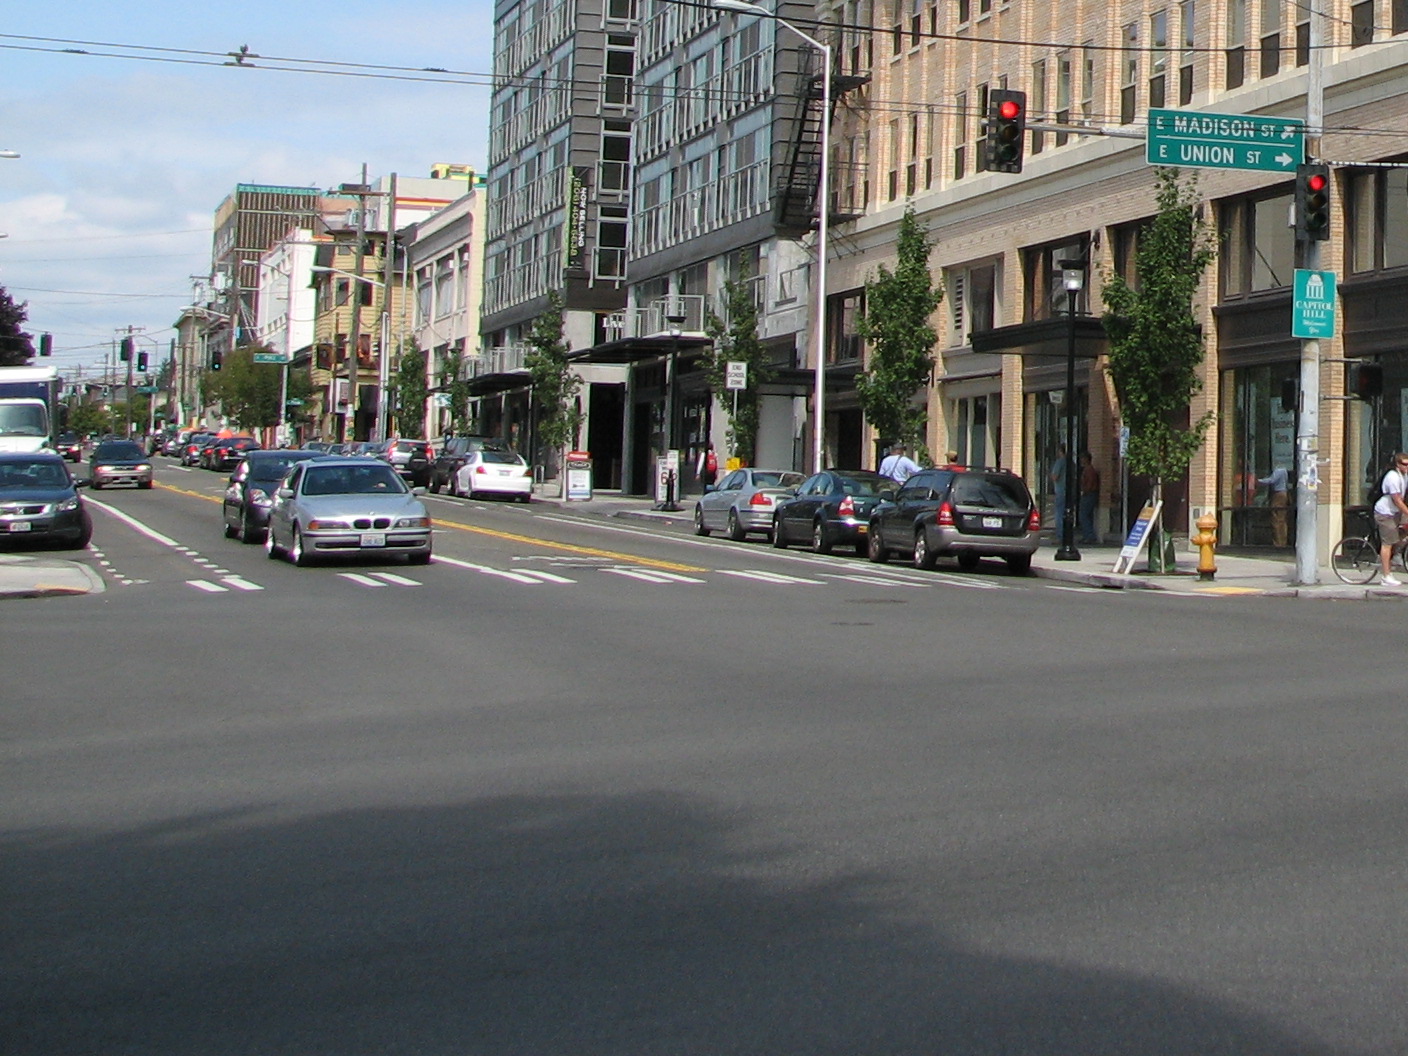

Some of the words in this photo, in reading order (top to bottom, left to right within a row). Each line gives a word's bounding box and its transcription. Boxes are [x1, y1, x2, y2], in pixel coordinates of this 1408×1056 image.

[1156, 116, 1165, 130] E
[1174, 115, 1254, 138] MADISON
[1261, 124, 1276, 138] ST
[1159, 144, 1168, 158] E
[1180, 144, 1234, 164] UNION
[1246, 151, 1261, 164] ST
[578, 209, 586, 247] SELLING
[1295, 300, 1334, 311] CAPITOL
[1302, 310, 1327, 319] HILL
